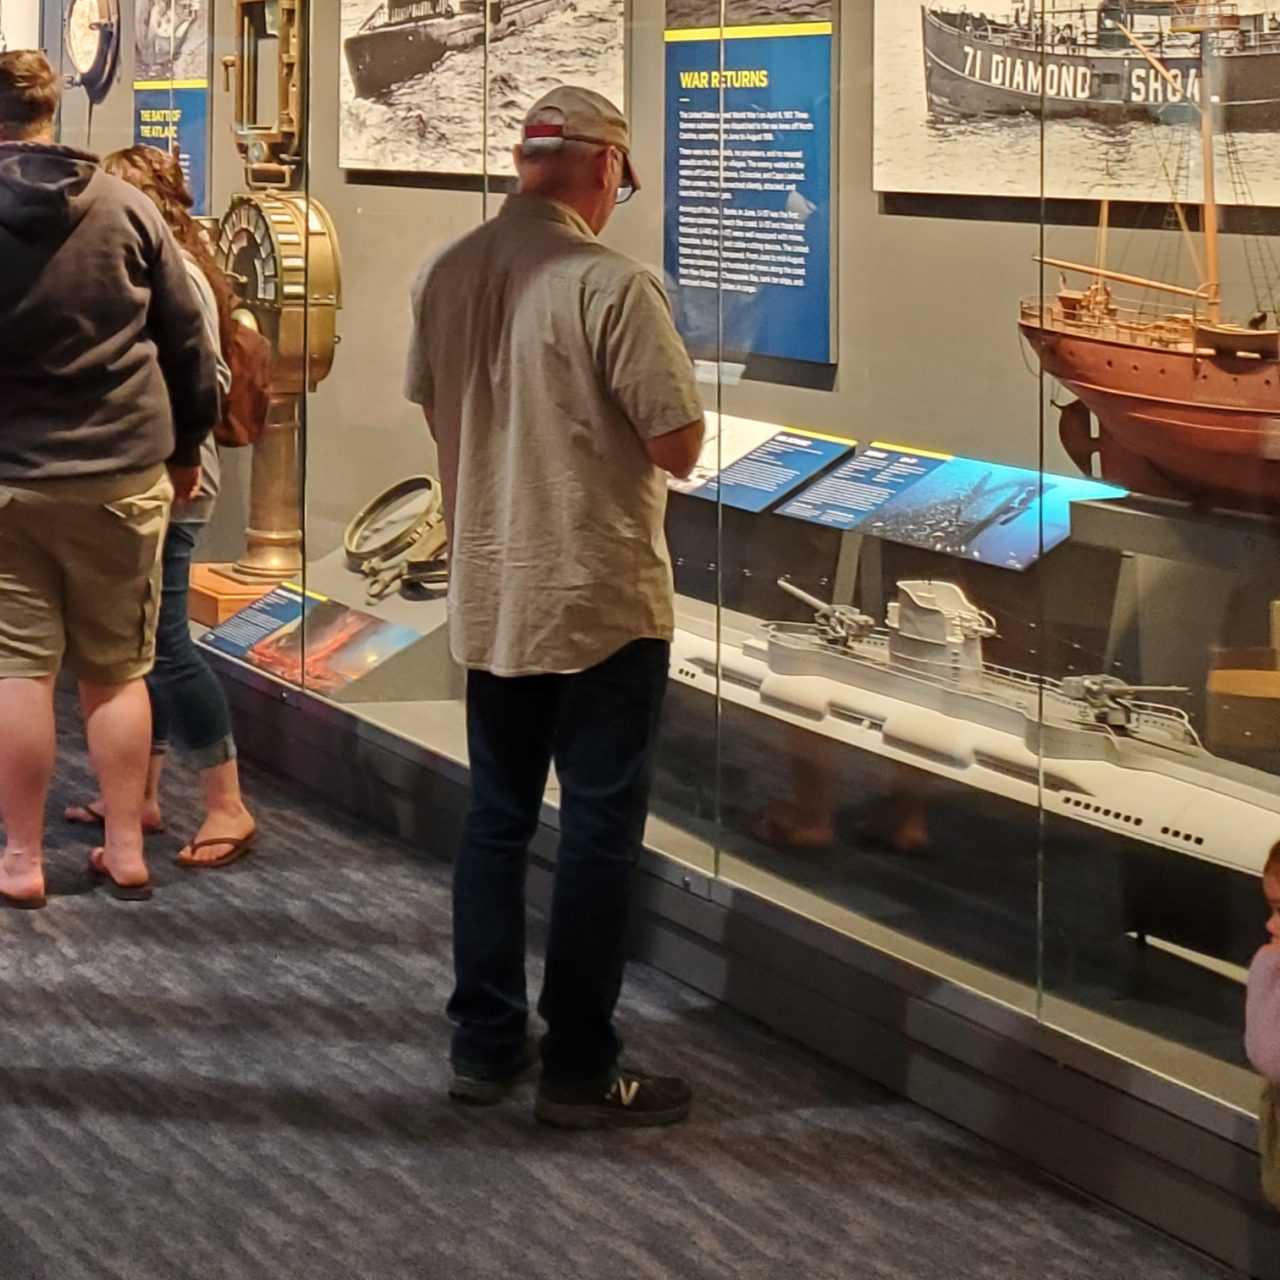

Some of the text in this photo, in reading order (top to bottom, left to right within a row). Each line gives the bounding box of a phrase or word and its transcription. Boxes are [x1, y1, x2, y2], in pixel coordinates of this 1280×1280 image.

[679, 71, 709, 88] WAR
[963, 46, 1220, 103] 71 DIAMOND SHOA
